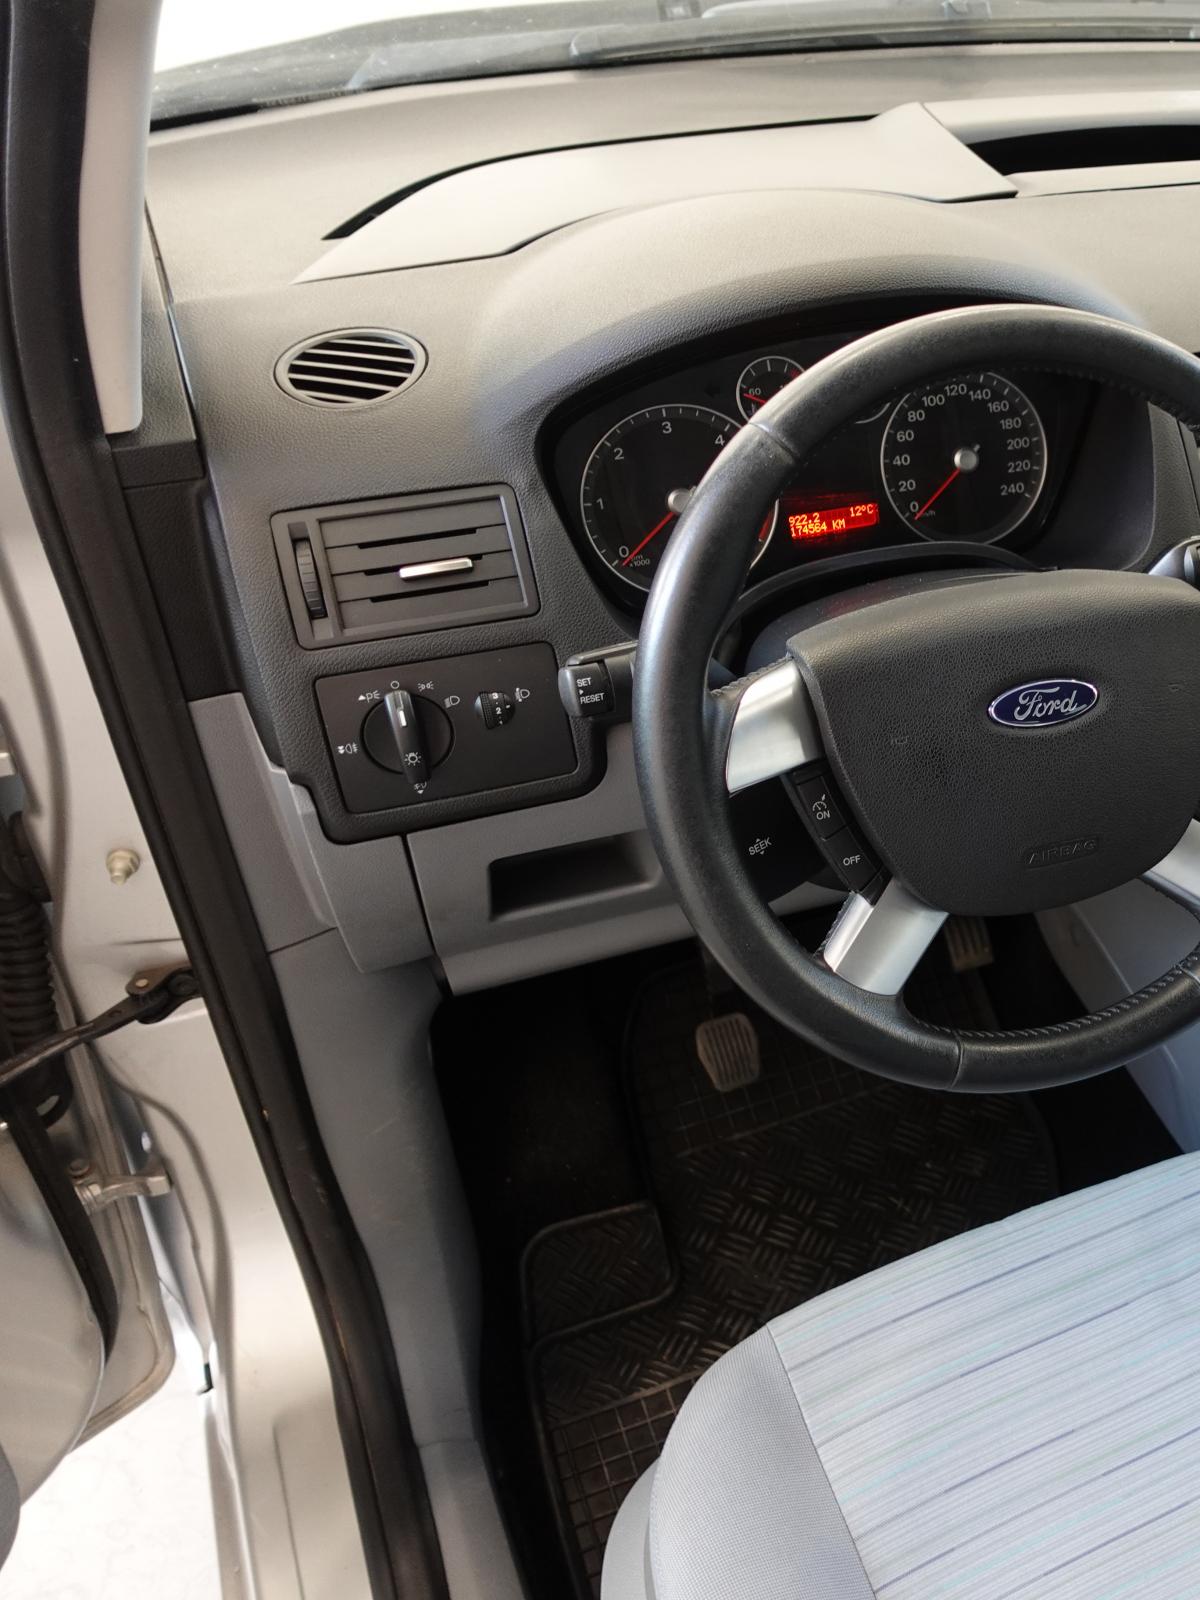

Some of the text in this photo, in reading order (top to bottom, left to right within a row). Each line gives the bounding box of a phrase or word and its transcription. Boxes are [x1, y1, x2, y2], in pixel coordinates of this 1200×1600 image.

[944, 383, 968, 397] 120
[968, 388, 992, 401] 140
[922, 394, 945, 407] 100
[987, 400, 1010, 413] 160
[907, 409, 926, 423] 80
[661, 421, 672, 434] 3
[1000, 417, 1022, 430] 180
[714, 435, 726, 446] 4
[896, 430, 915, 443] 60
[1006, 437, 1030, 450] 200
[613, 448, 625, 461] 2
[892, 454, 911, 466] 40
[1008, 460, 1031, 473] 220
[898, 479, 916, 493] 20
[1000, 483, 1025, 496] 240
[596, 498, 604, 510] 1
[910, 501, 919, 513] 0
[788, 503, 875, 527] 922.2 12°C
[831, 518, 846, 531] KM
[618, 545, 630, 558] 0
[576, 677, 592, 688] SET
[492, 692, 499, 700] 3
[580, 692, 605, 705] RESET
[1013, 686, 1088, 721] Ford
[495, 706, 502, 715] 2
[816, 810, 831, 821] ON
[748, 836, 773, 856] SEEK
[1027, 839, 1098, 865] AIRBAG
[842, 855, 861, 866] OFF
